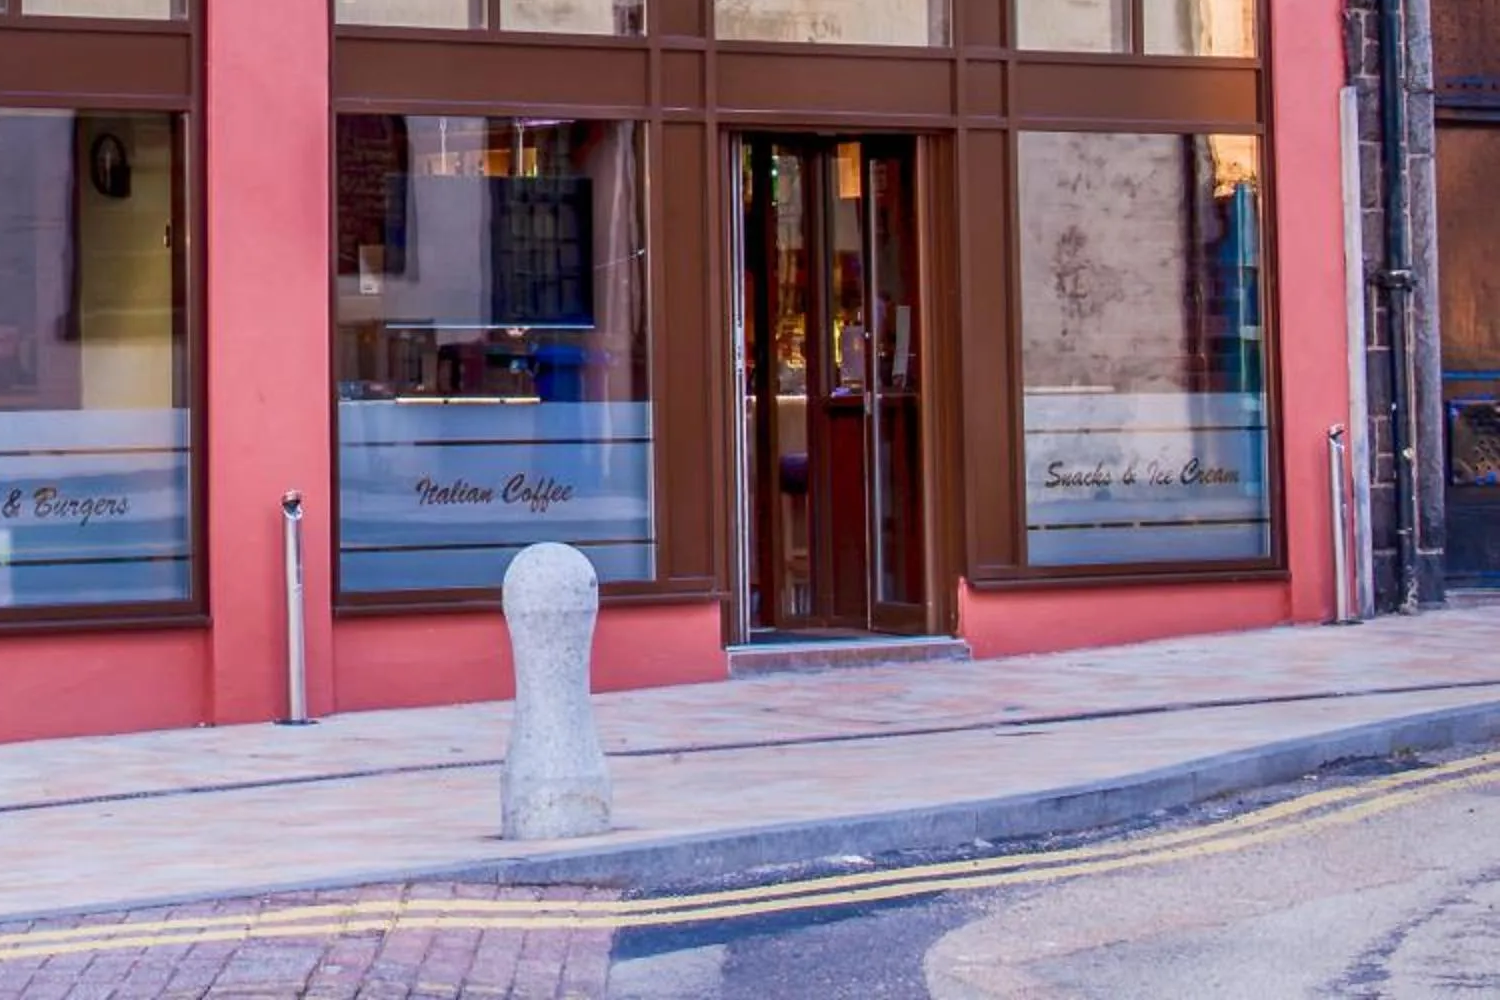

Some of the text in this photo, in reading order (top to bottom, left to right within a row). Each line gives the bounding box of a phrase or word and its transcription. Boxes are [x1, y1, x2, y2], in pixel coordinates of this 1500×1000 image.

[1044, 457, 1240, 488] Snacks & Ice Cream
[1, 488, 23, 518] &
[33, 487, 130, 527] Burgers
[415, 473, 575, 513] Italian Coffee
